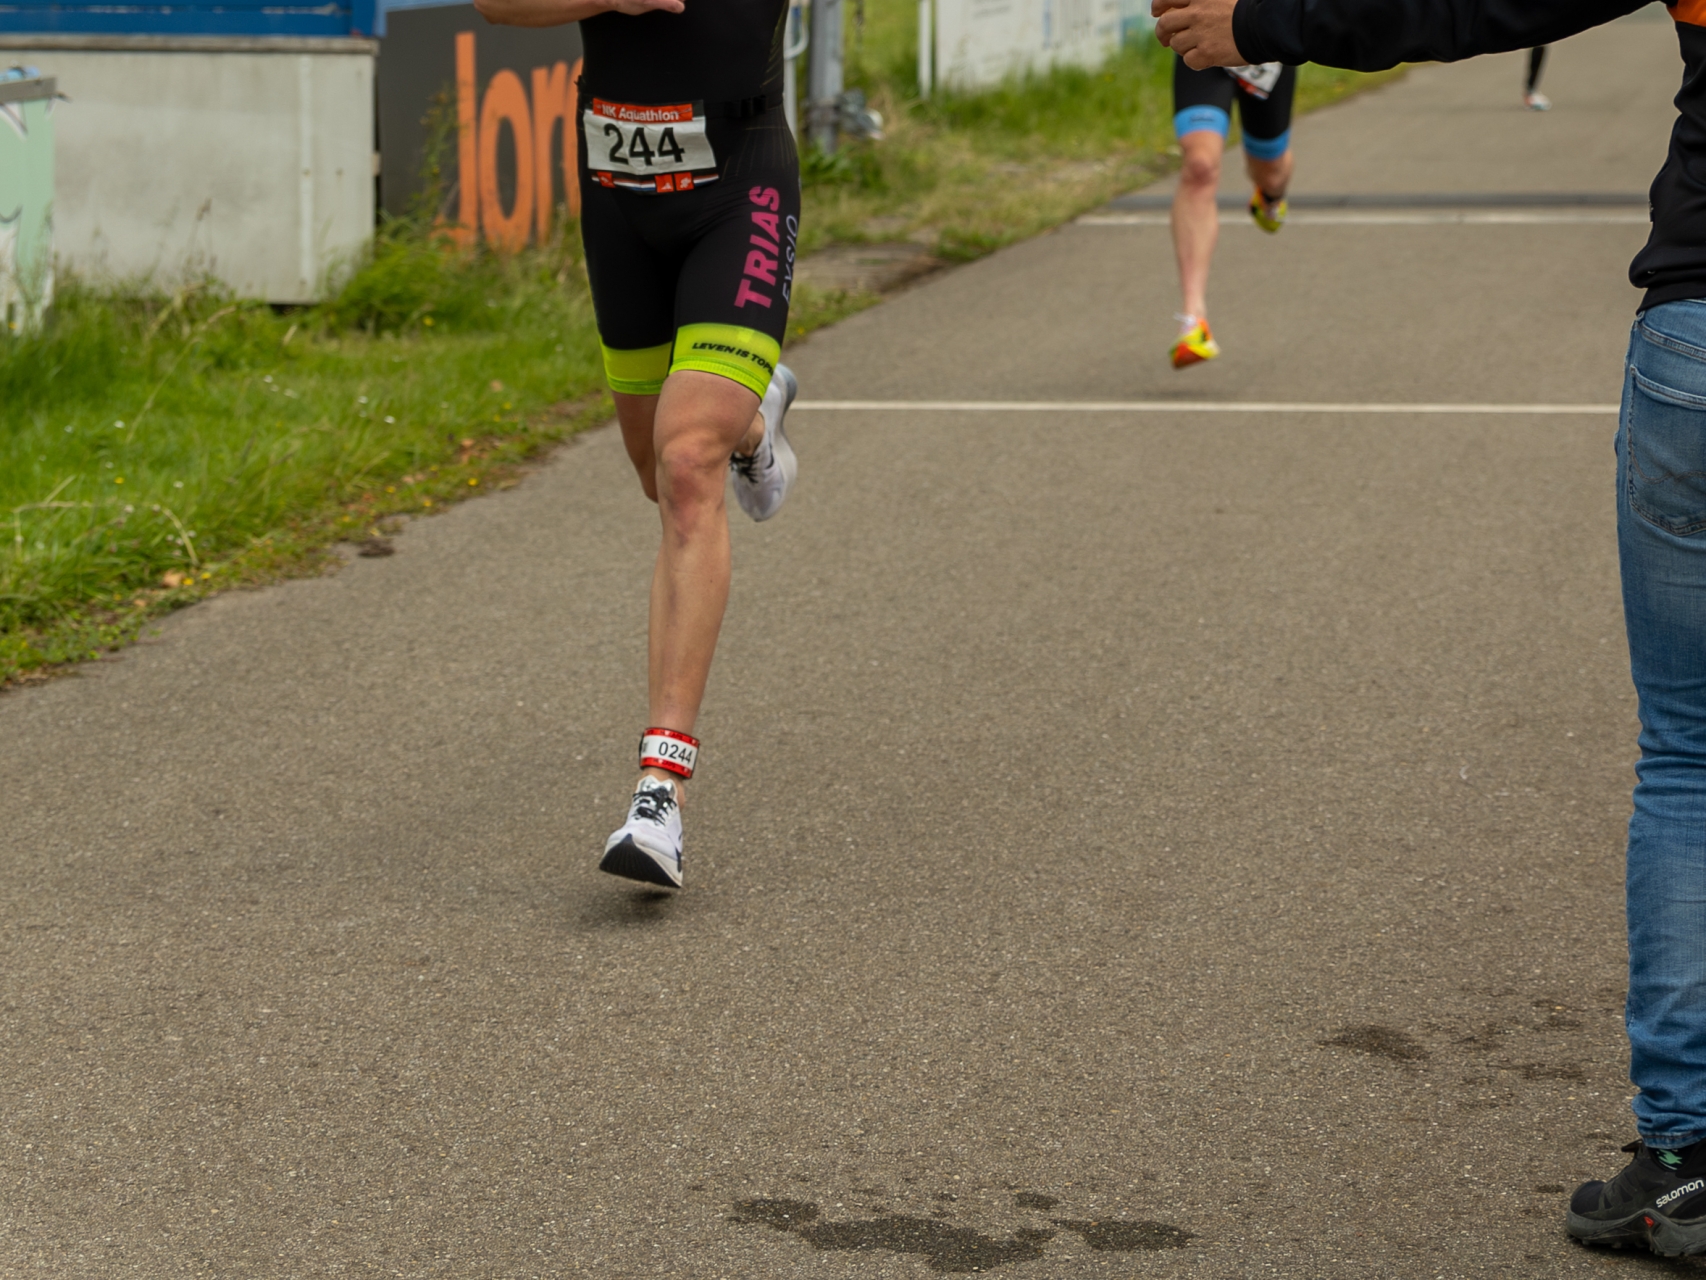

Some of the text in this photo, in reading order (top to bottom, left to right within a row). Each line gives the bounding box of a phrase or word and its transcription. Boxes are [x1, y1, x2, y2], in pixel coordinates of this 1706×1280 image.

[601, 103, 679, 122] NK Aquathlon
[603, 122, 685, 166] 244
[734, 186, 780, 309] TRIAS
[692, 342, 736, 354] LEVEN
[736, 349, 750, 358] IS
[658, 741, 693, 764] 0244
